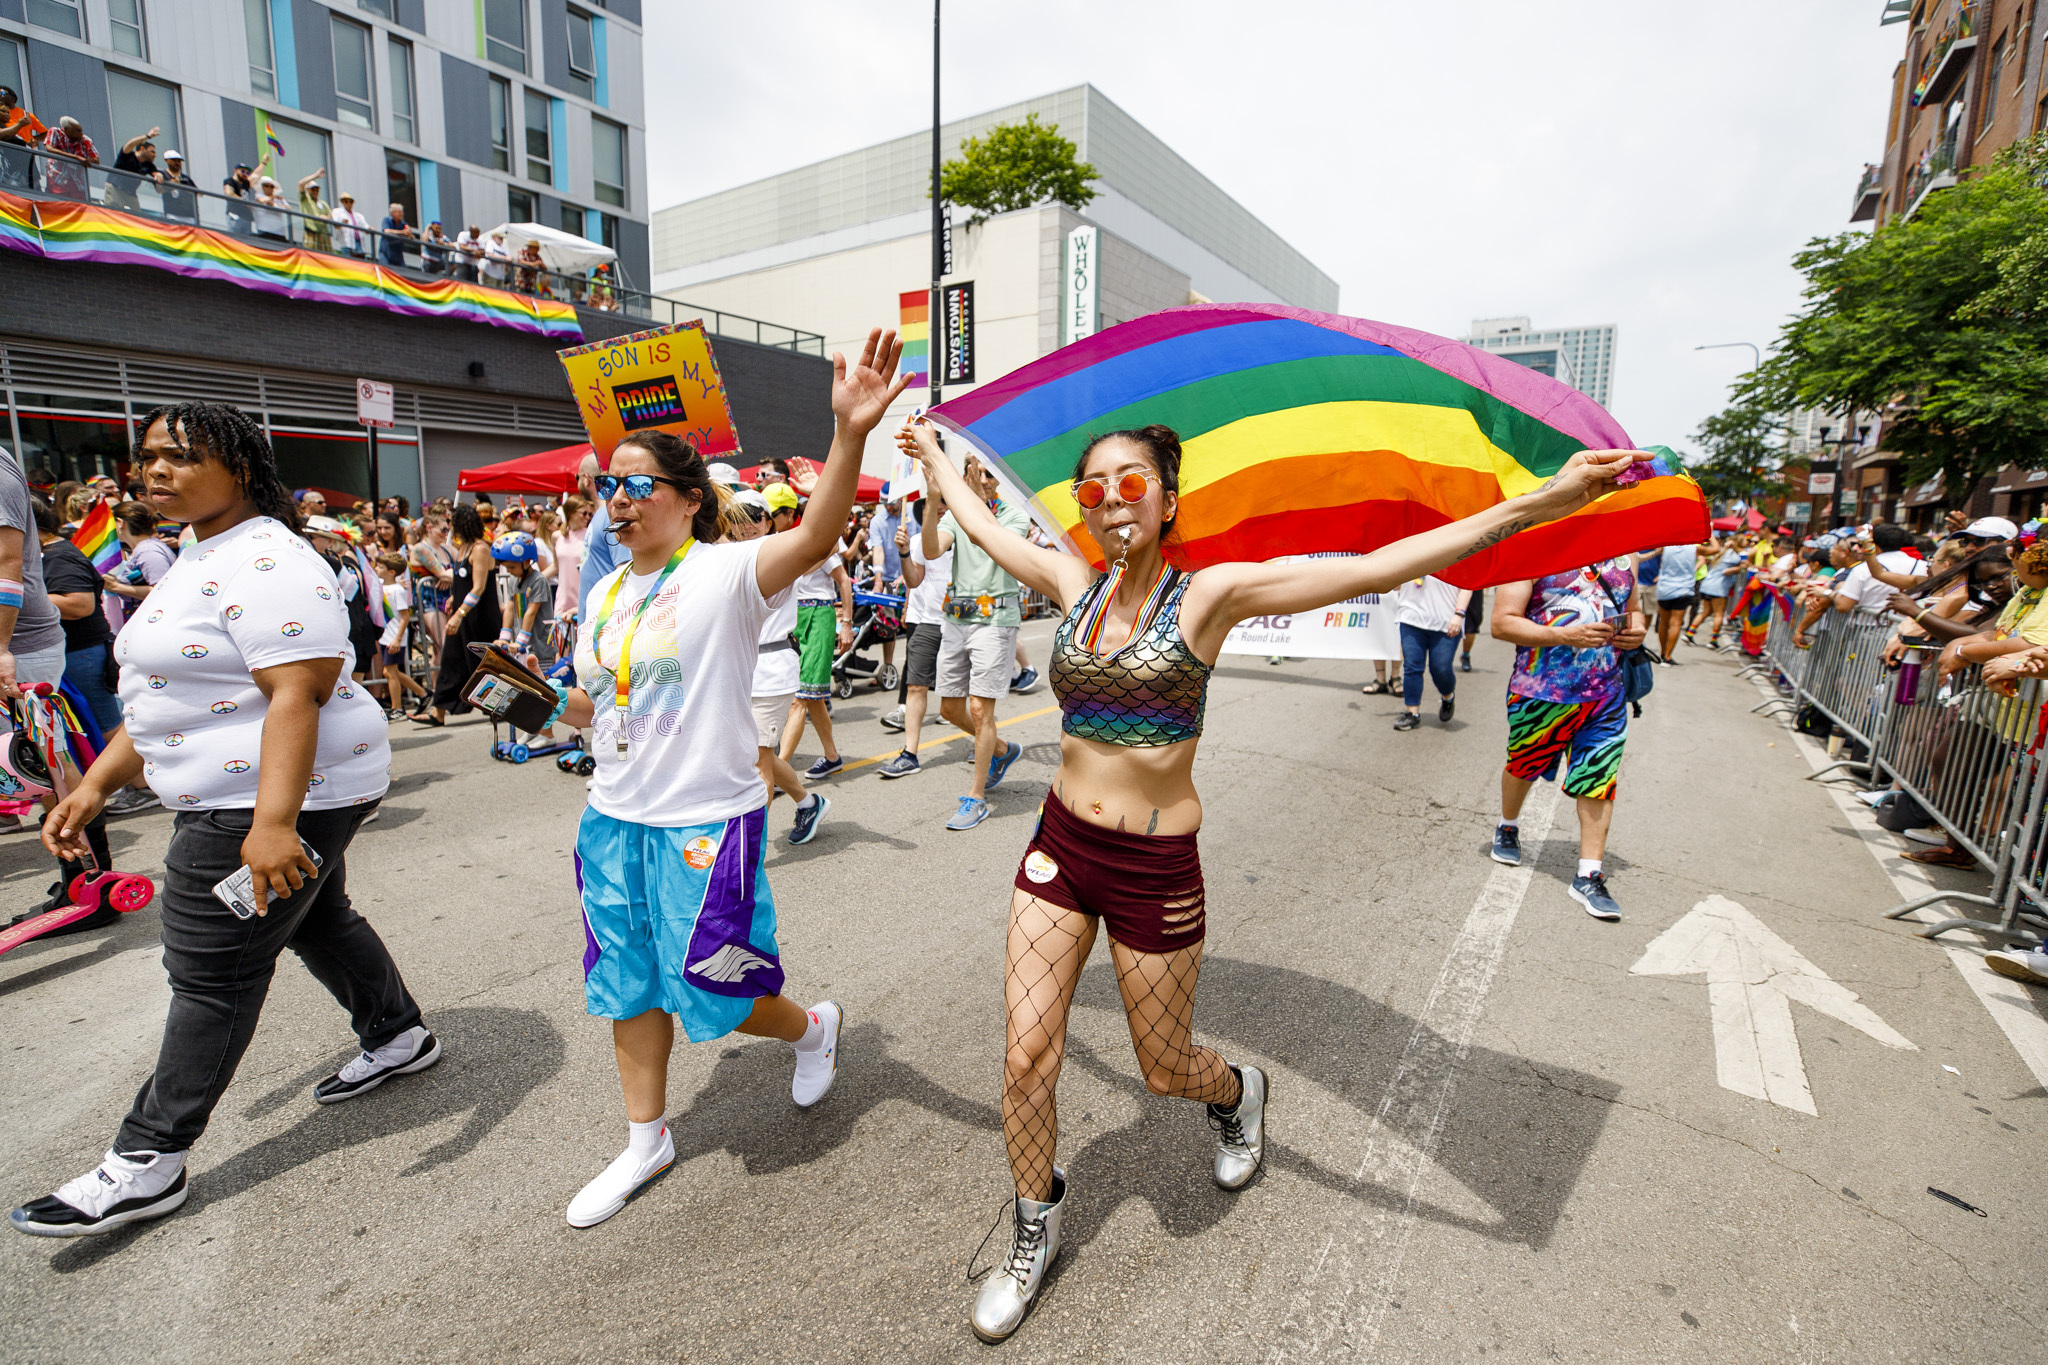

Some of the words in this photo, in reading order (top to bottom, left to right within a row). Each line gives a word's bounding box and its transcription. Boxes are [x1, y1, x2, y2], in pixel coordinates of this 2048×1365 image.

[1074, 234, 1090, 327] WHOLE
[949, 289, 960, 379] BOYSTOWN
[588, 378, 608, 418] MY
[598, 346, 639, 377] SON
[648, 342, 671, 365] IS
[682, 360, 715, 399] MY
[615, 382, 683, 423] PRIDE
[1241, 632, 1269, 642] Round
[1270, 633, 1291, 643] Lake
[1324, 612, 1370, 628] PRIDE!
[1028, 868, 1051, 878] PFLAG
[688, 944, 776, 983] NIKE
